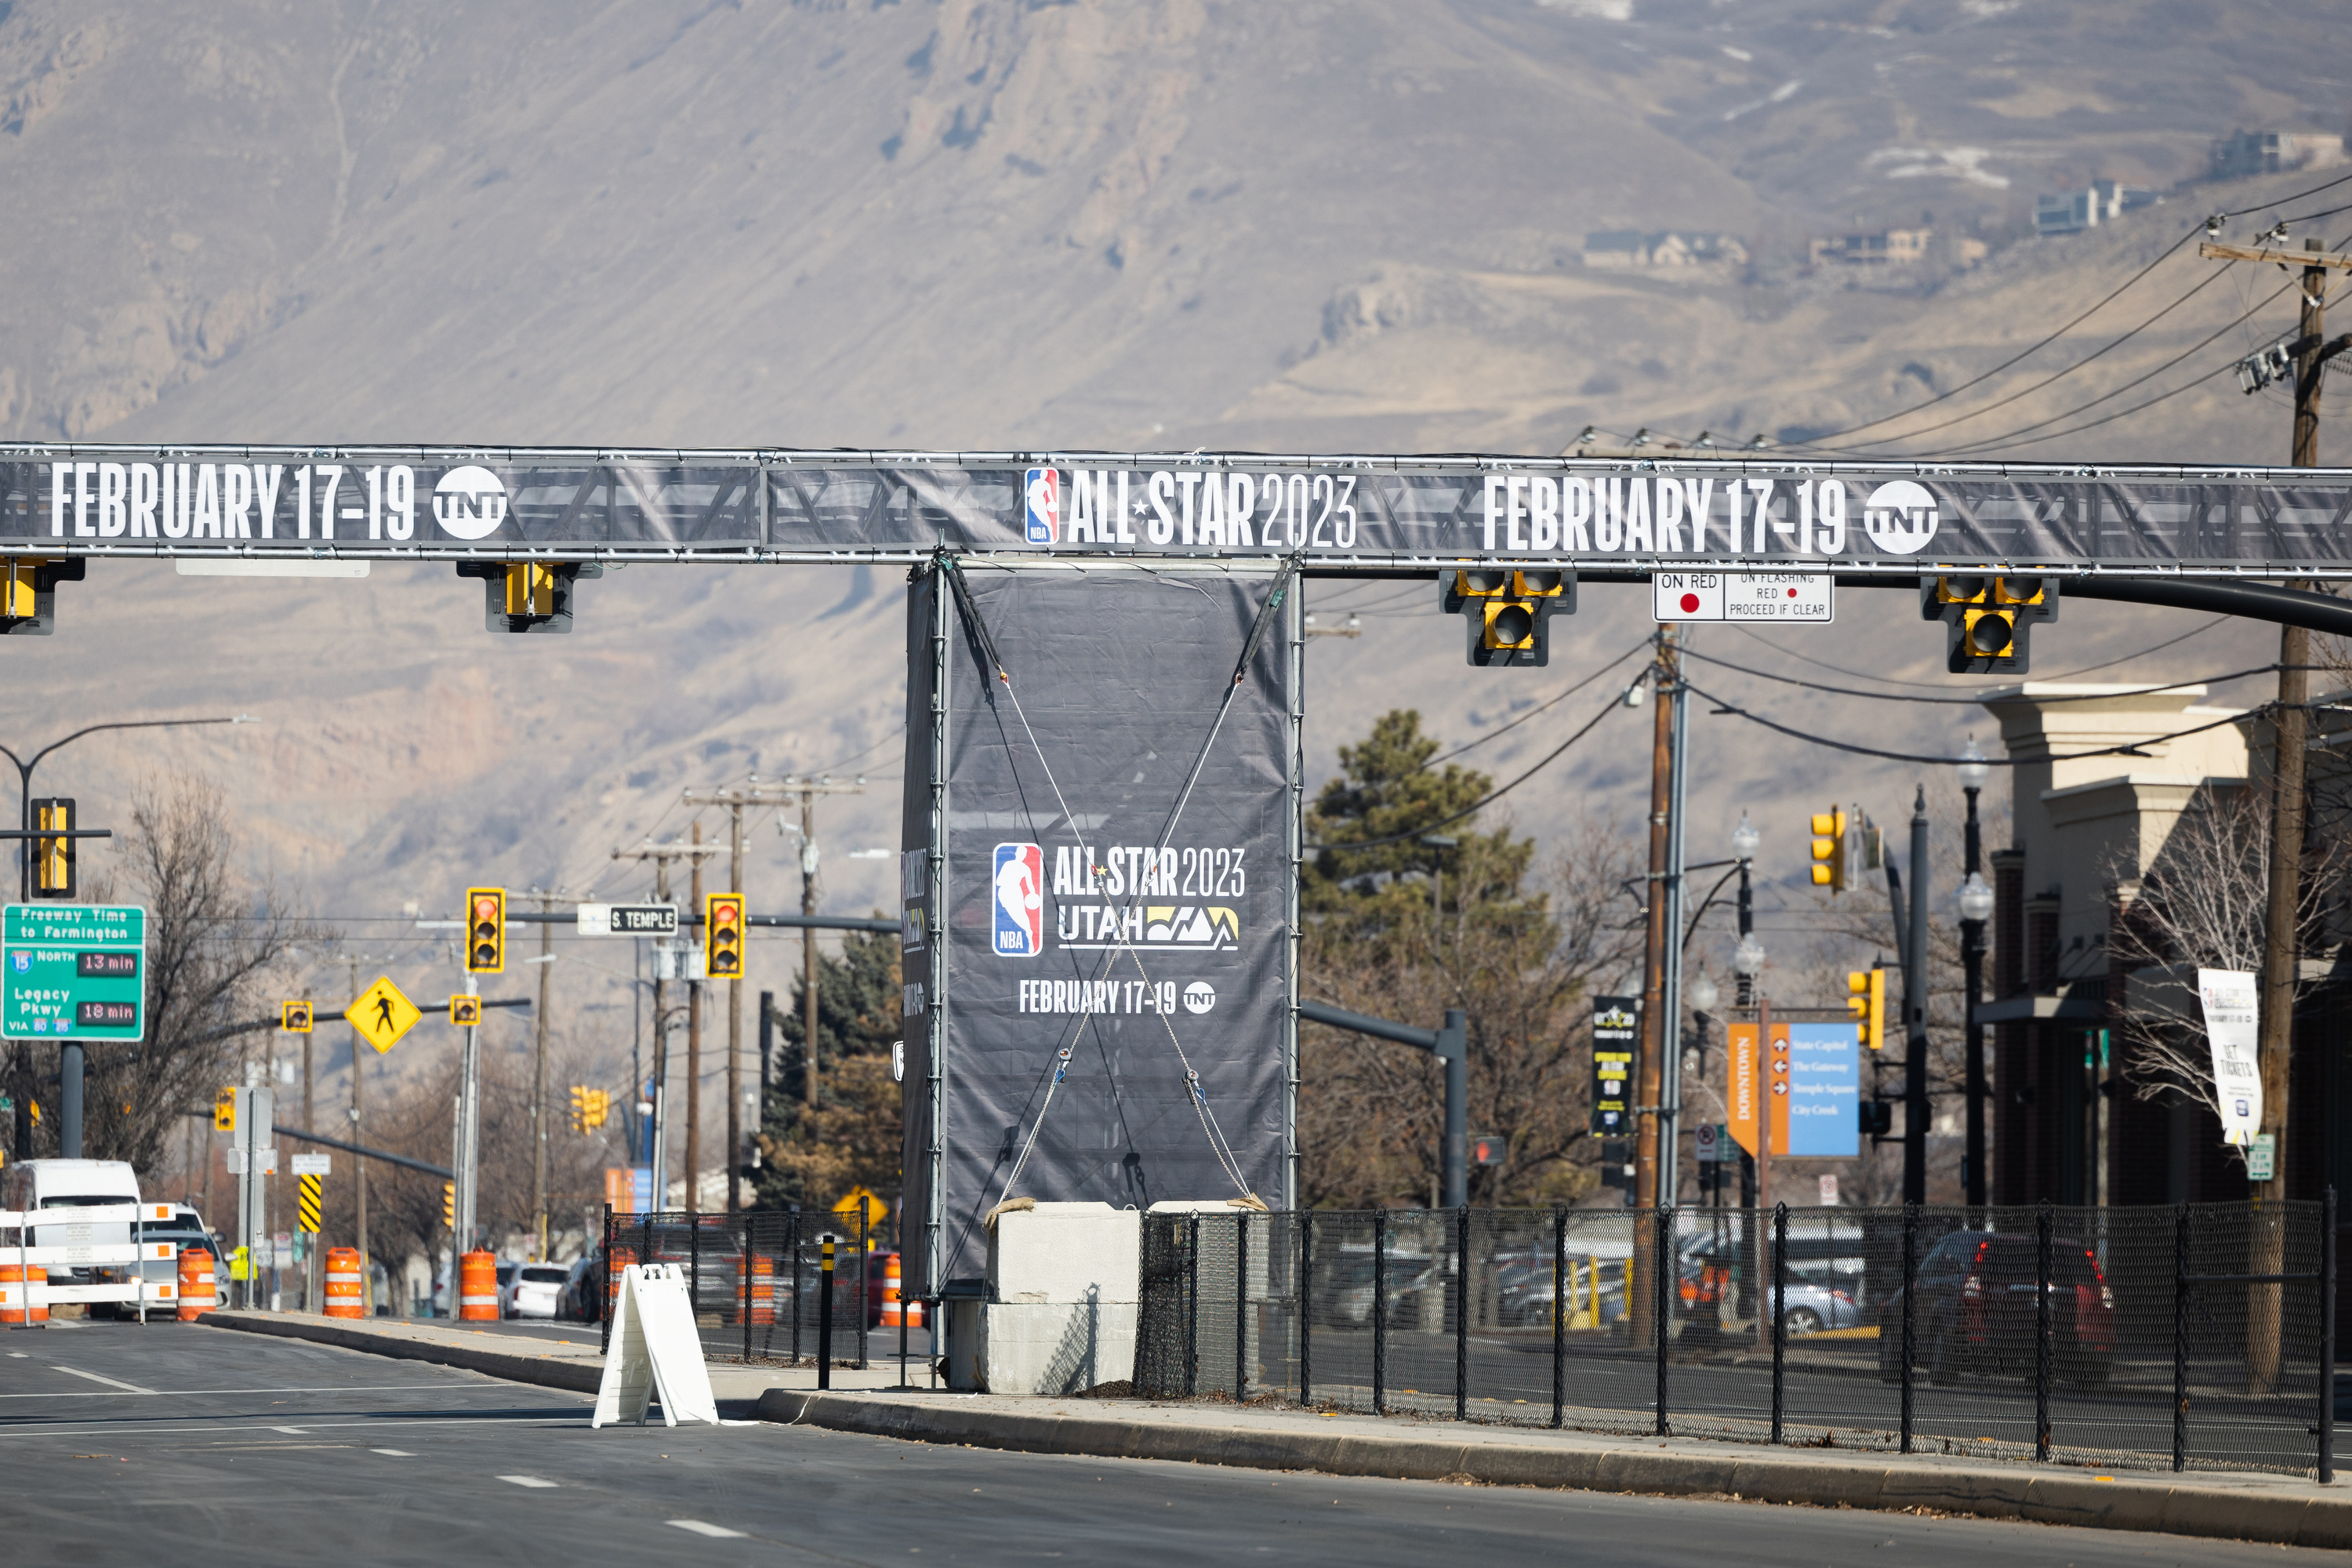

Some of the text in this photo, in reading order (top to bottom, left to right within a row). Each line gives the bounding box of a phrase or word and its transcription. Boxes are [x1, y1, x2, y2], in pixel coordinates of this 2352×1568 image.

[52, 462, 415, 541] FEBRUARY 17-19
[1262, 473, 1356, 549] 2023
[1483, 476, 1846, 554] FEBRUARY 17-19
[1030, 527, 1047, 540] NBA
[1662, 575, 1717, 589] ON RED
[1758, 588, 1778, 599] RED
[1730, 604, 1825, 615] PROCEED IF CLEAR
[1182, 848, 1246, 897] 2023
[21, 909, 128, 924] Freeway Time
[626, 911, 674, 929] TEMPLE
[1058, 905, 1144, 941] UTAH
[21, 926, 128, 942] to Farmington
[1000, 931, 1024, 949] NBA
[15, 956, 29, 970] 15
[108, 954, 133, 970] min
[15, 987, 70, 1004] Legacy
[1020, 979, 1177, 1014] FEBRUARY 17-19
[20, 1002, 61, 1018] Pkwy
[108, 1004, 133, 1019] min
[9, 1021, 28, 1031] VIA
[1792, 1040, 1848, 1052] State Capitol
[1793, 1061, 1849, 1074] The Gateway
[1737, 1036, 1751, 1120] DOWNTOWN
[1793, 1083, 1857, 1096] Temple Square
[1791, 1104, 1838, 1117] City Creek
